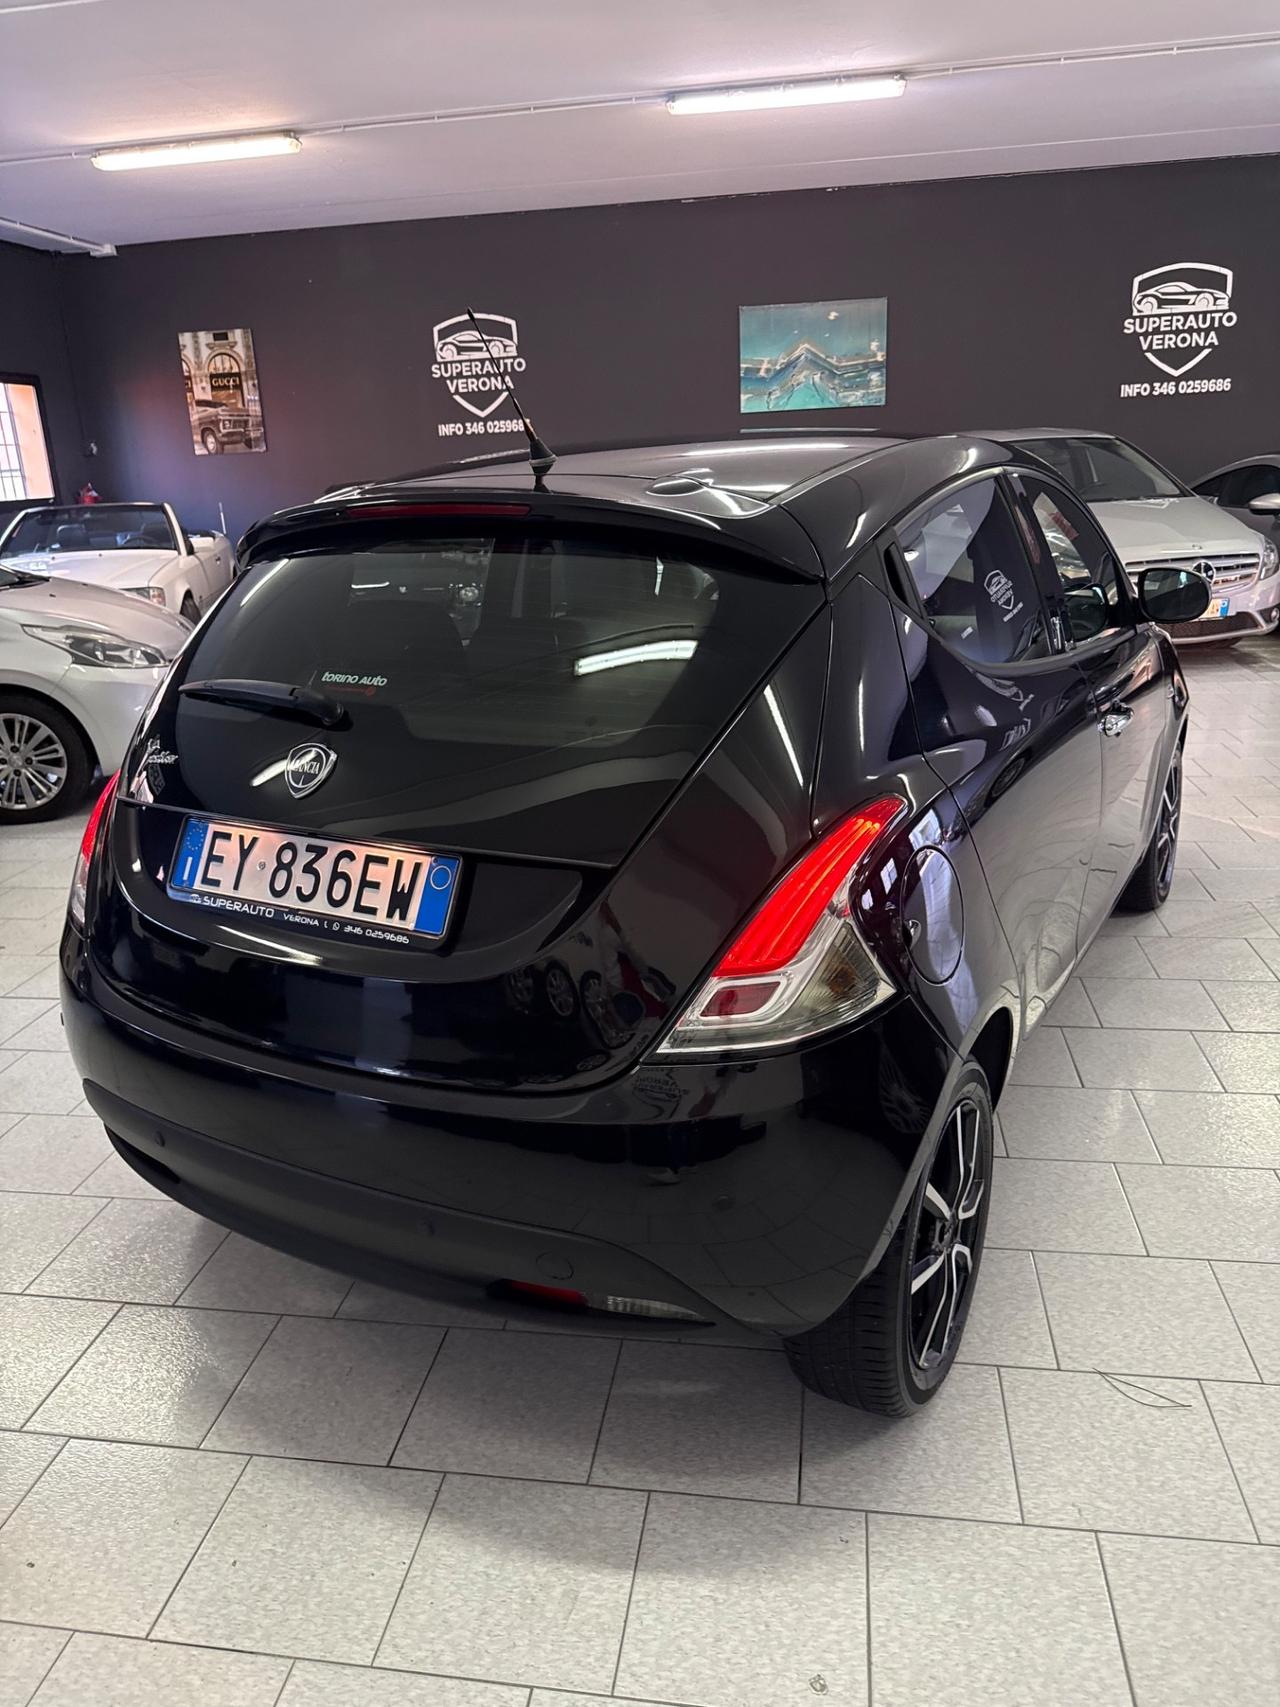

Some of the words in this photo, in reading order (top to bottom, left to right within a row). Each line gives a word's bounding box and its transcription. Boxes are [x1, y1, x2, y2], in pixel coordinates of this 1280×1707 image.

[1123, 311, 1238, 334] SUPERAUTO
[1139, 331, 1219, 351] VERONA
[431, 358, 526, 378] SUPERAUTO
[211, 377, 240, 386] GUCCI
[446, 375, 514, 393] VERONA
[1120, 383, 1151, 398] INFO
[1152, 382, 1176, 395] 346
[1178, 378, 1232, 394] 0259686
[438, 423, 464, 436] INFO
[465, 421, 485, 435] 346
[486, 418, 531, 433] 025968
[182, 856, 193, 881] I
[200, 830, 259, 891] EY
[268, 840, 422, 921] 836EW
[203, 895, 275, 918] SUPERAUTO
[283, 912, 320, 927] VERONA
[343, 924, 363, 935] 346
[365, 928, 410, 944] 0259686
